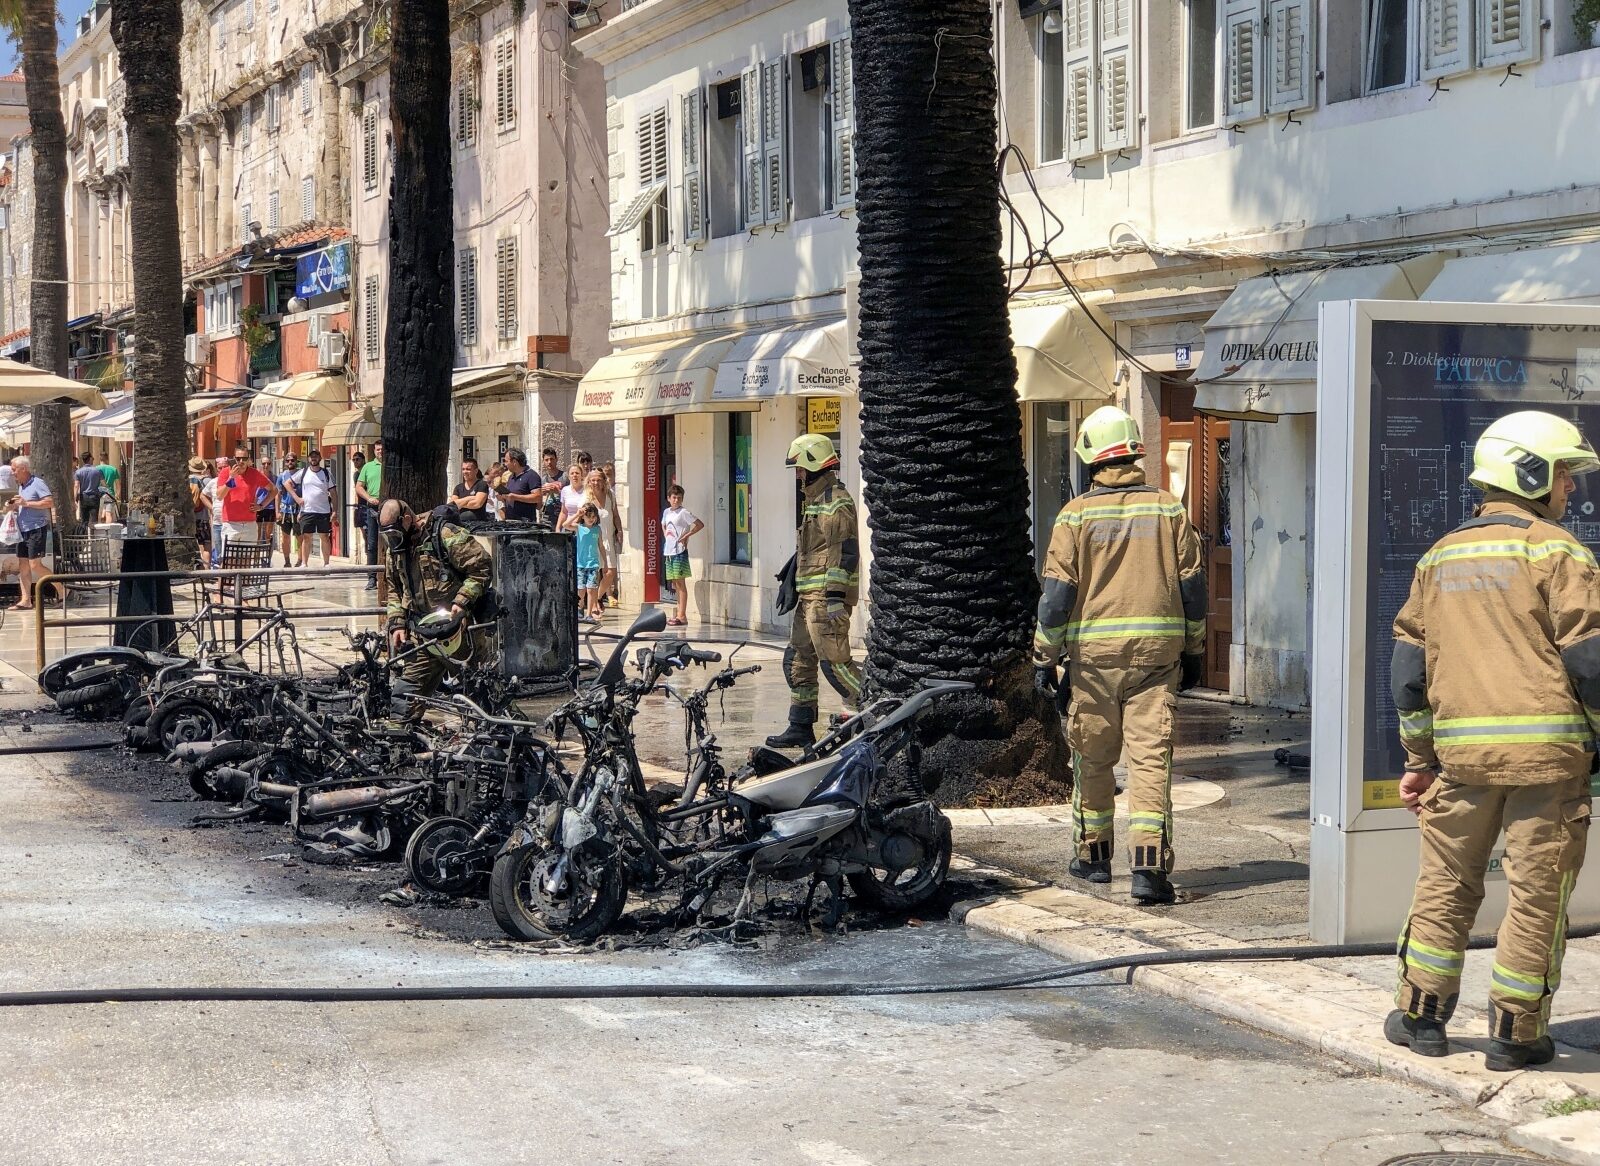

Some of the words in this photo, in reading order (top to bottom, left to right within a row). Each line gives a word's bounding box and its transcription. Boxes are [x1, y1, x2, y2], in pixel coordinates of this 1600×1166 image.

[1176, 347, 1187, 360] 23
[1221, 343, 1265, 361] OPTIKA
[1386, 351, 1397, 366] 2.
[1402, 350, 1497, 369] Dioklecijanova
[821, 367, 849, 376] Money
[1435, 356, 1528, 383] PALAČA
[798, 374, 851, 386] Exchange
[625, 387, 644, 399] BARTS
[812, 409, 840, 425] Exchang
[646, 434, 656, 491] havaianas
[646, 518, 657, 575] havaianas
